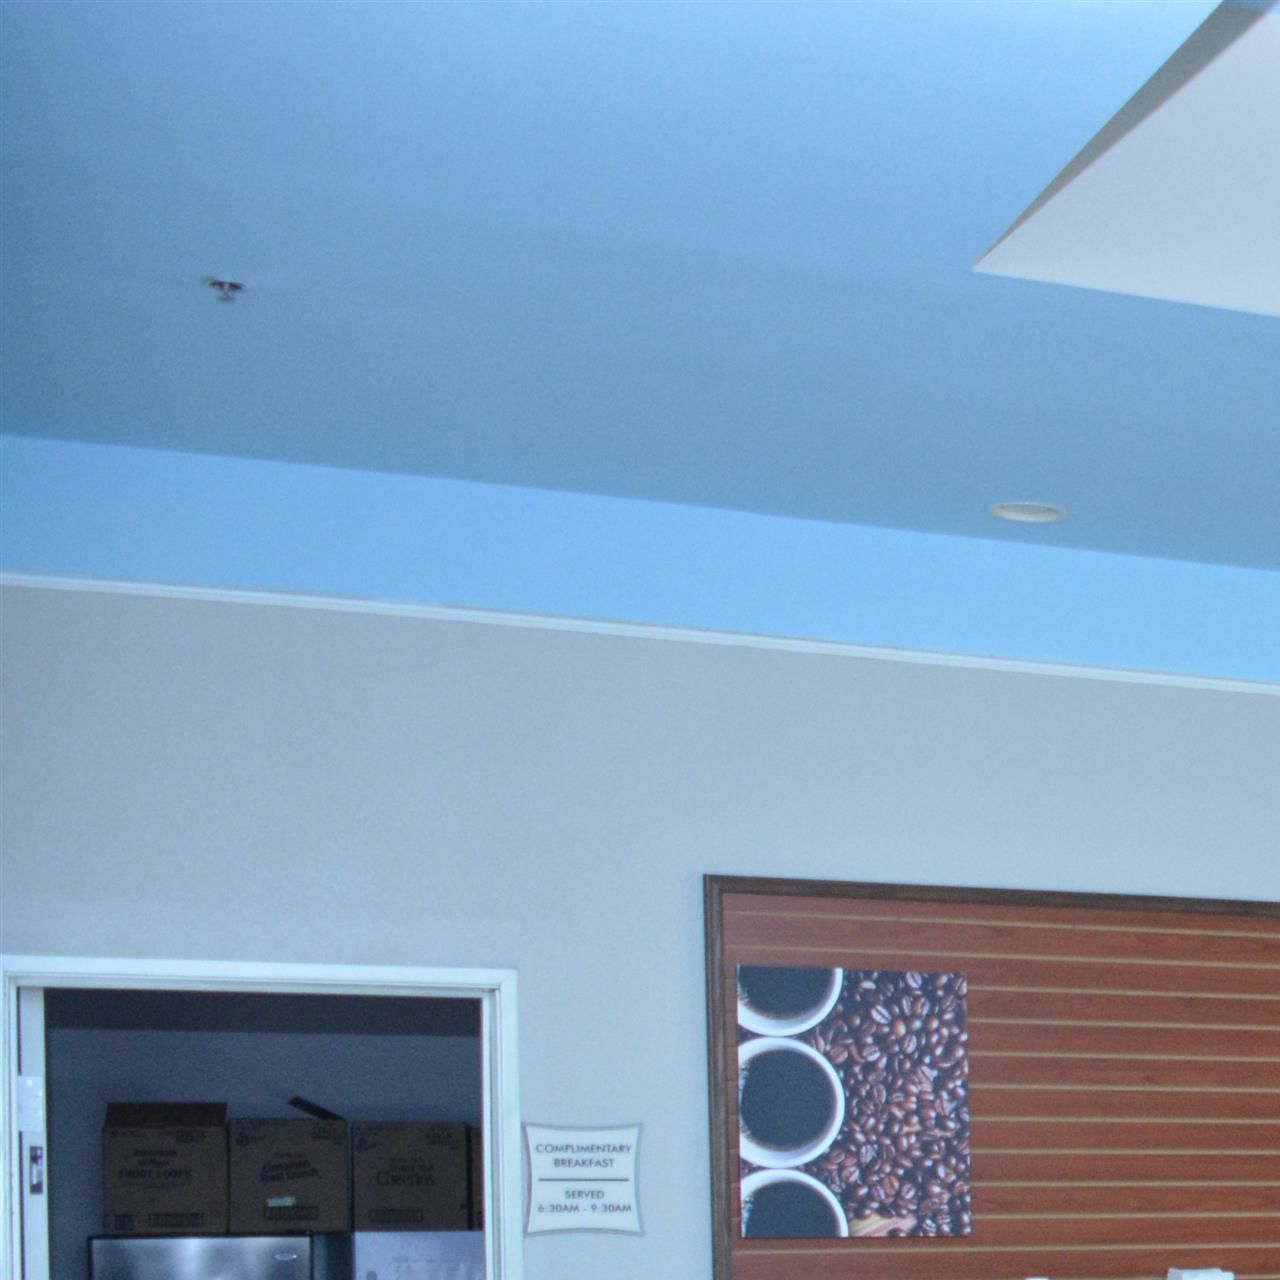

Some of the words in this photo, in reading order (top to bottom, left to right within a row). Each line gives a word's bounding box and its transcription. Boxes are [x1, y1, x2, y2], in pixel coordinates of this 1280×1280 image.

[535, 1143, 632, 1154] COMPLIMENTARY
[553, 1158, 615, 1168] BREAKFAST
[564, 1190, 605, 1200] SERVED
